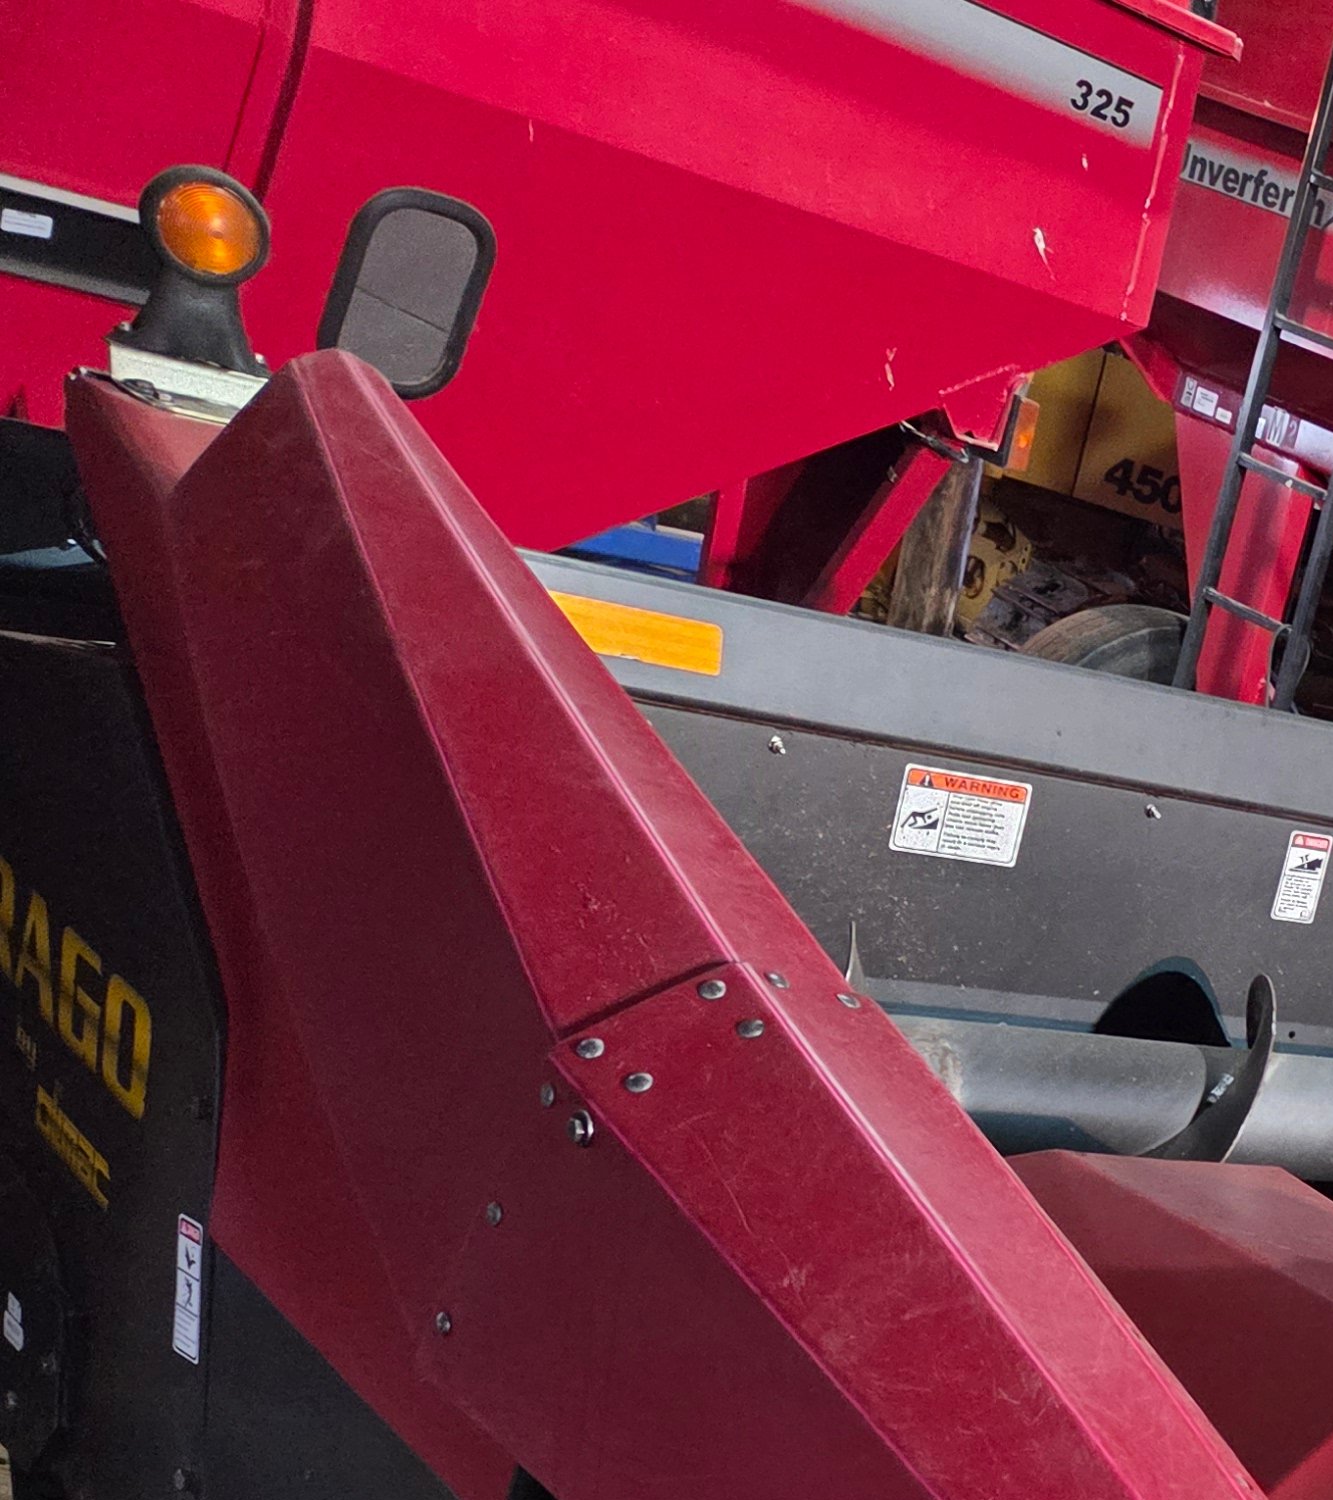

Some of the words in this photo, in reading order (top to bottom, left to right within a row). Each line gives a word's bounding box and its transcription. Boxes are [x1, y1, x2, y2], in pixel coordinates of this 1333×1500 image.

[1070, 79, 1135, 128] 325
[1182, 144, 1325, 226] nverfer
[944, 776, 1020, 799] WARNING
